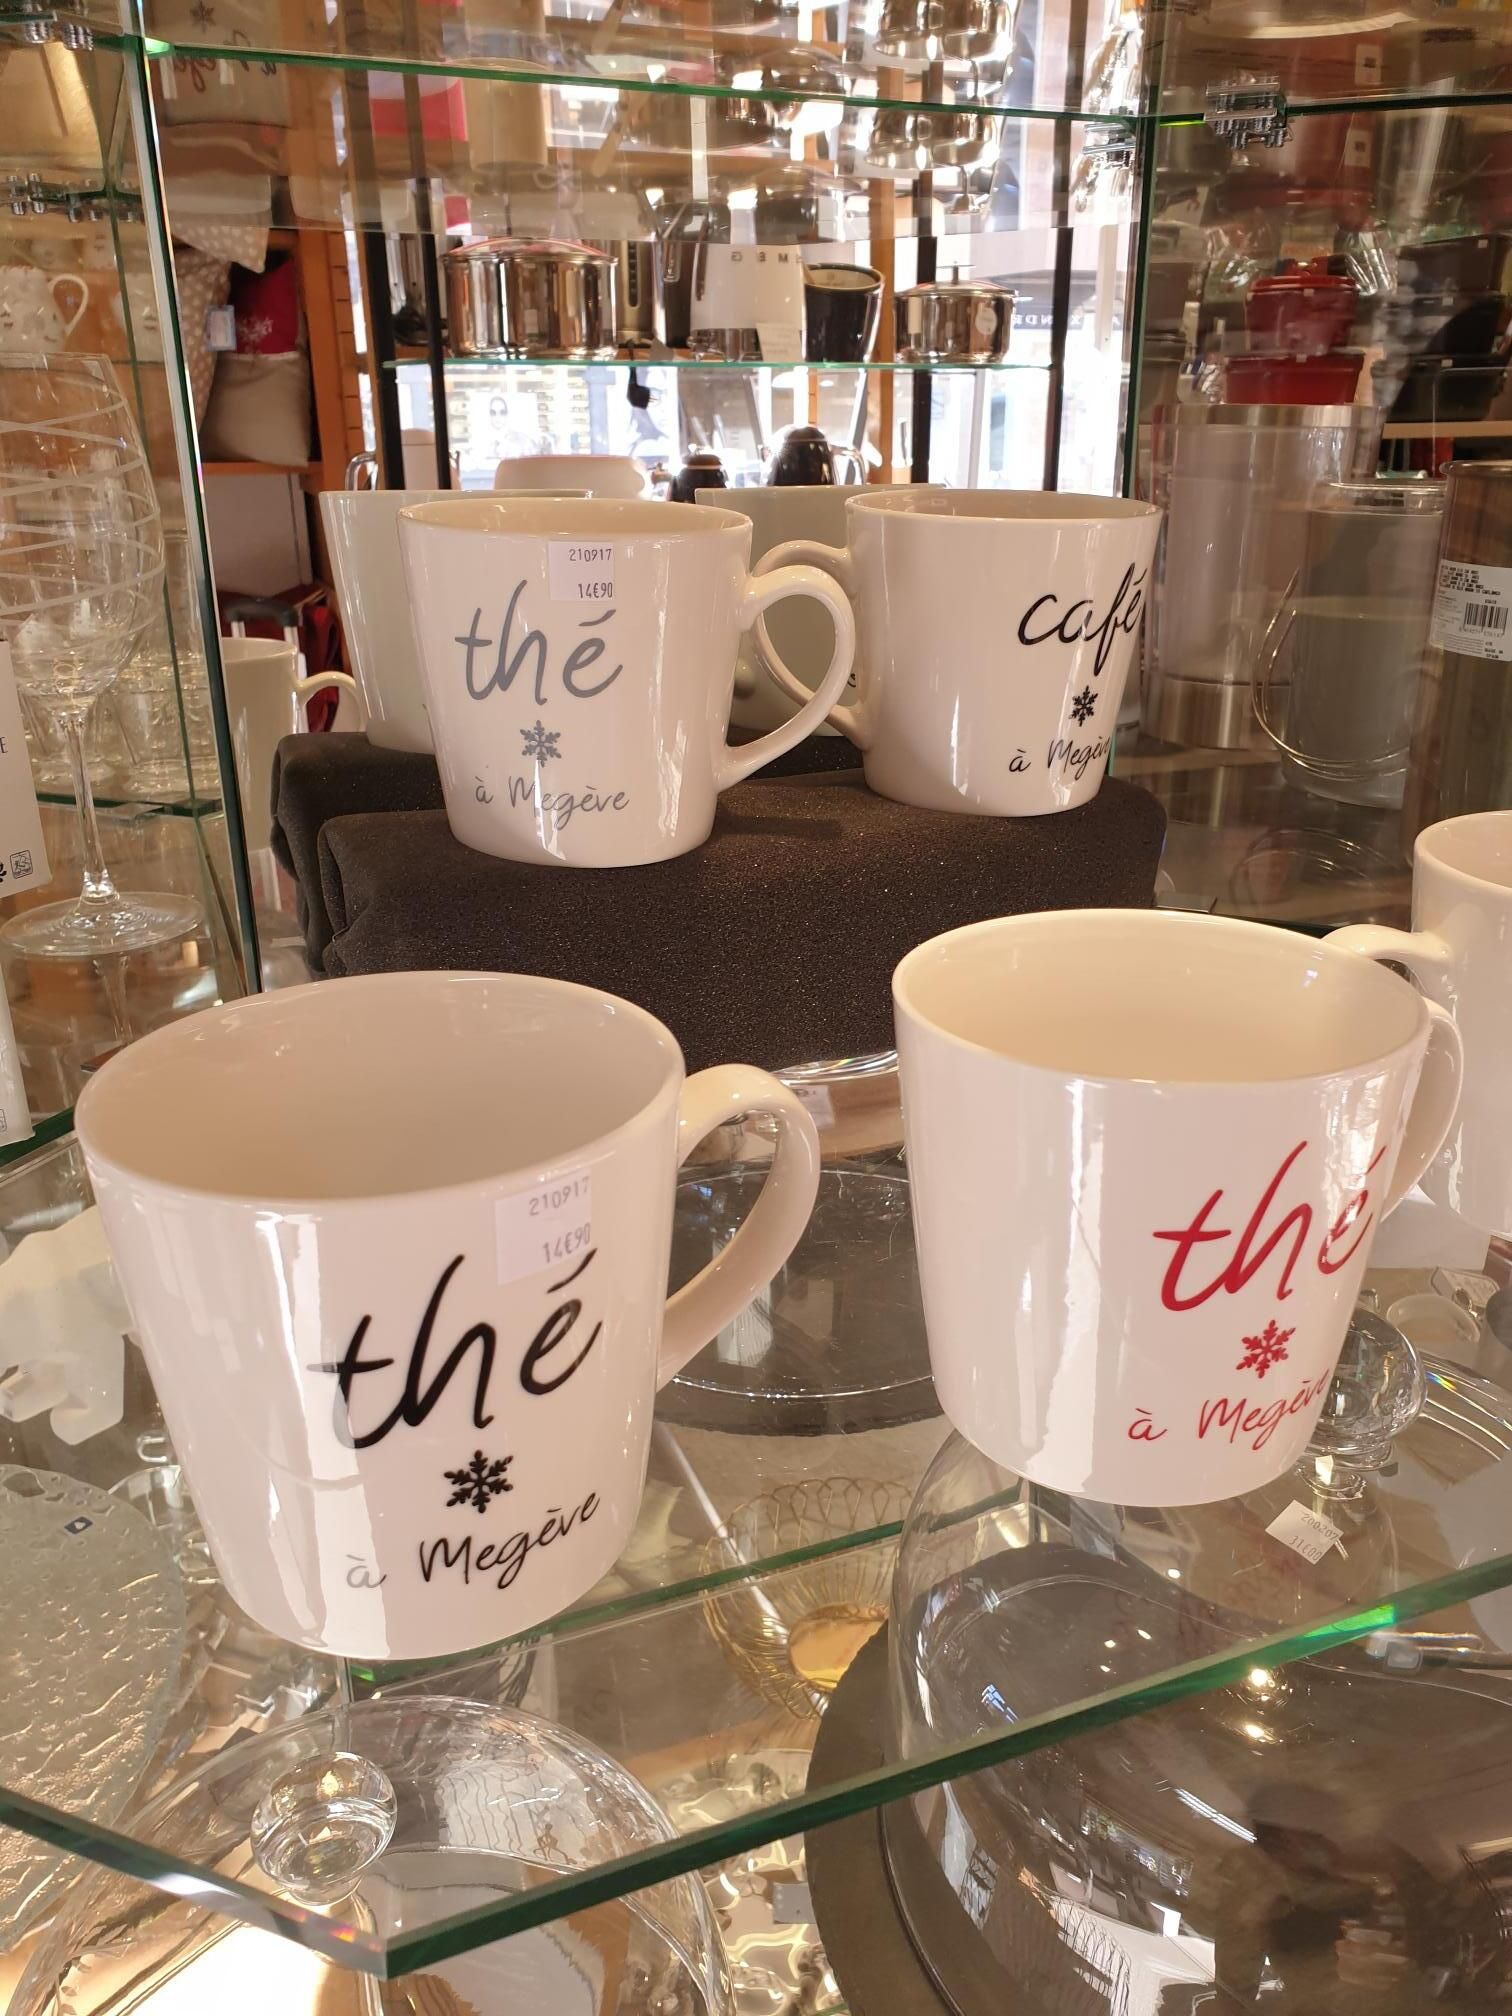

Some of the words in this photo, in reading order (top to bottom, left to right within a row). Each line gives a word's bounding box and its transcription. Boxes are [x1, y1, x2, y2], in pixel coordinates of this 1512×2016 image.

[568, 547, 613, 563] 210917
[578, 581, 614, 600] 14€90
[1017, 562, 1148, 676] café
[454, 579, 623, 706] thé
[1008, 748, 1031, 773] à
[475, 776, 494, 804] à
[508, 775, 630, 830] Megève
[528, 1176, 591, 1217] 210917
[542, 1222, 592, 1264] 14€90
[1152, 1140, 1387, 1312] thé
[306, 1247, 603, 1449] thé
[1128, 1408, 1168, 1441] à
[346, 1554, 386, 1589] à
[418, 1492, 600, 1589] Megève
[1300, 1513, 1340, 1542] 200207
